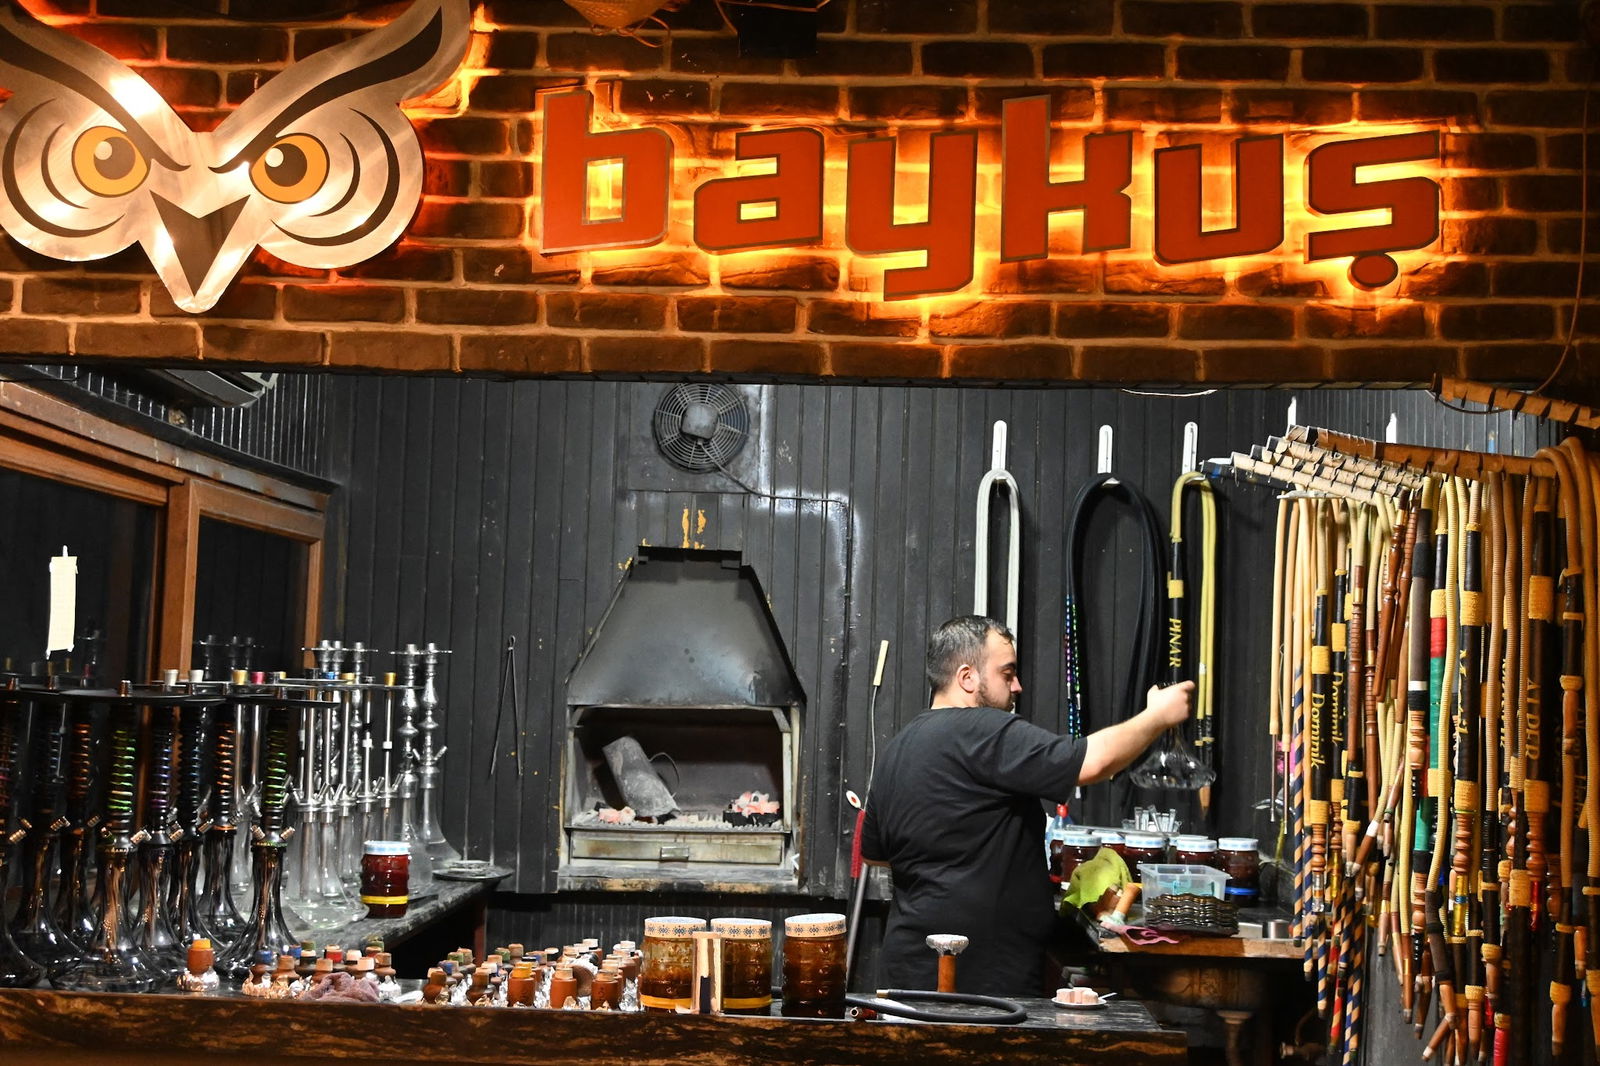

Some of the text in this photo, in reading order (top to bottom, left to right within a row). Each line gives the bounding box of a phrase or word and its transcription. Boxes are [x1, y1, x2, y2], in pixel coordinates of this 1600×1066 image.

[540, 87, 1440, 301] baykuş
[1169, 617, 1182, 668] PINAR
[1310, 692, 1326, 770] Dominik
